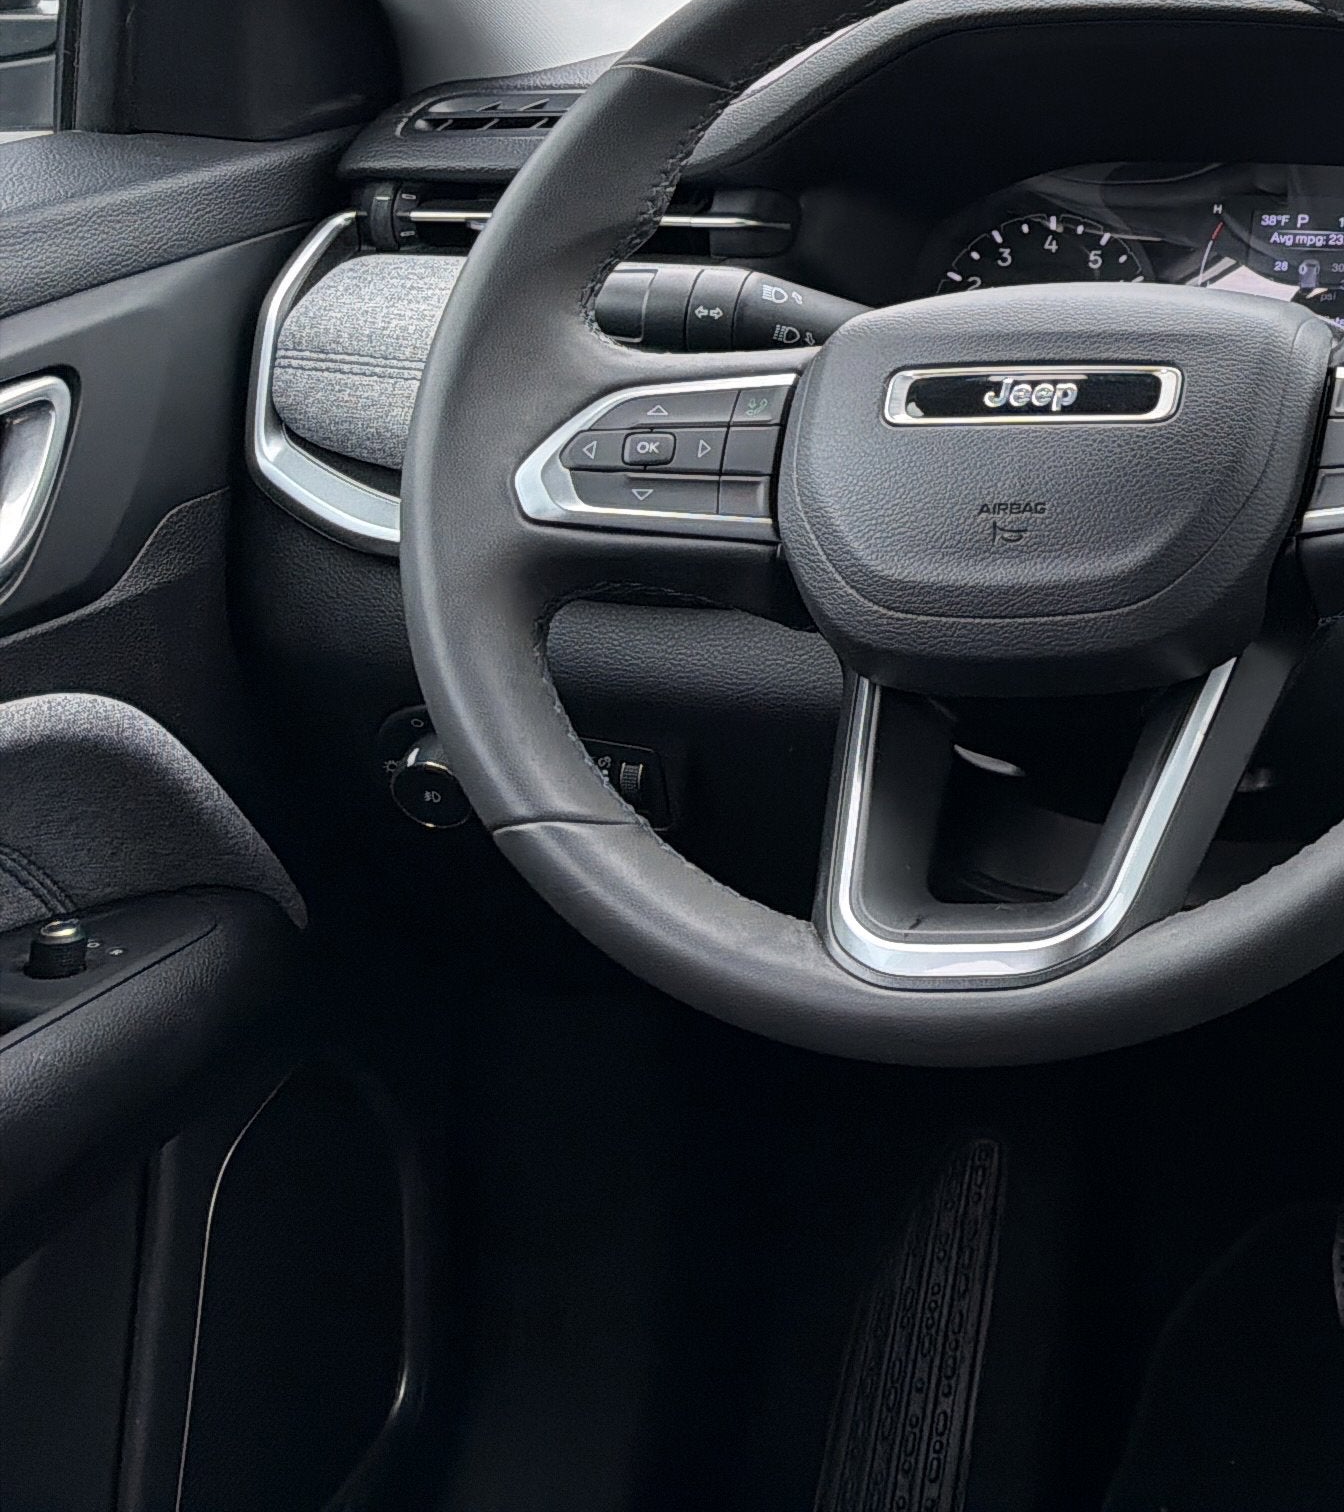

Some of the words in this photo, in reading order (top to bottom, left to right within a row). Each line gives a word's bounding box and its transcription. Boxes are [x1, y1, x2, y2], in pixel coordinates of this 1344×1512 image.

[1212, 203, 1224, 215] H
[1260, 213, 1291, 227] 38°F
[1296, 213, 1310, 228] P
[1043, 235, 1059, 254] 4
[1269, 231, 1293, 247] Avg
[1294, 234, 1328, 248] mpg:
[996, 247, 1013, 268] 3
[1087, 250, 1104, 270] 5
[1273, 261, 1290, 272] 28
[983, 377, 1079, 412] Jeep
[635, 440, 661, 455] OK
[978, 501, 1048, 516] AIRBAG
